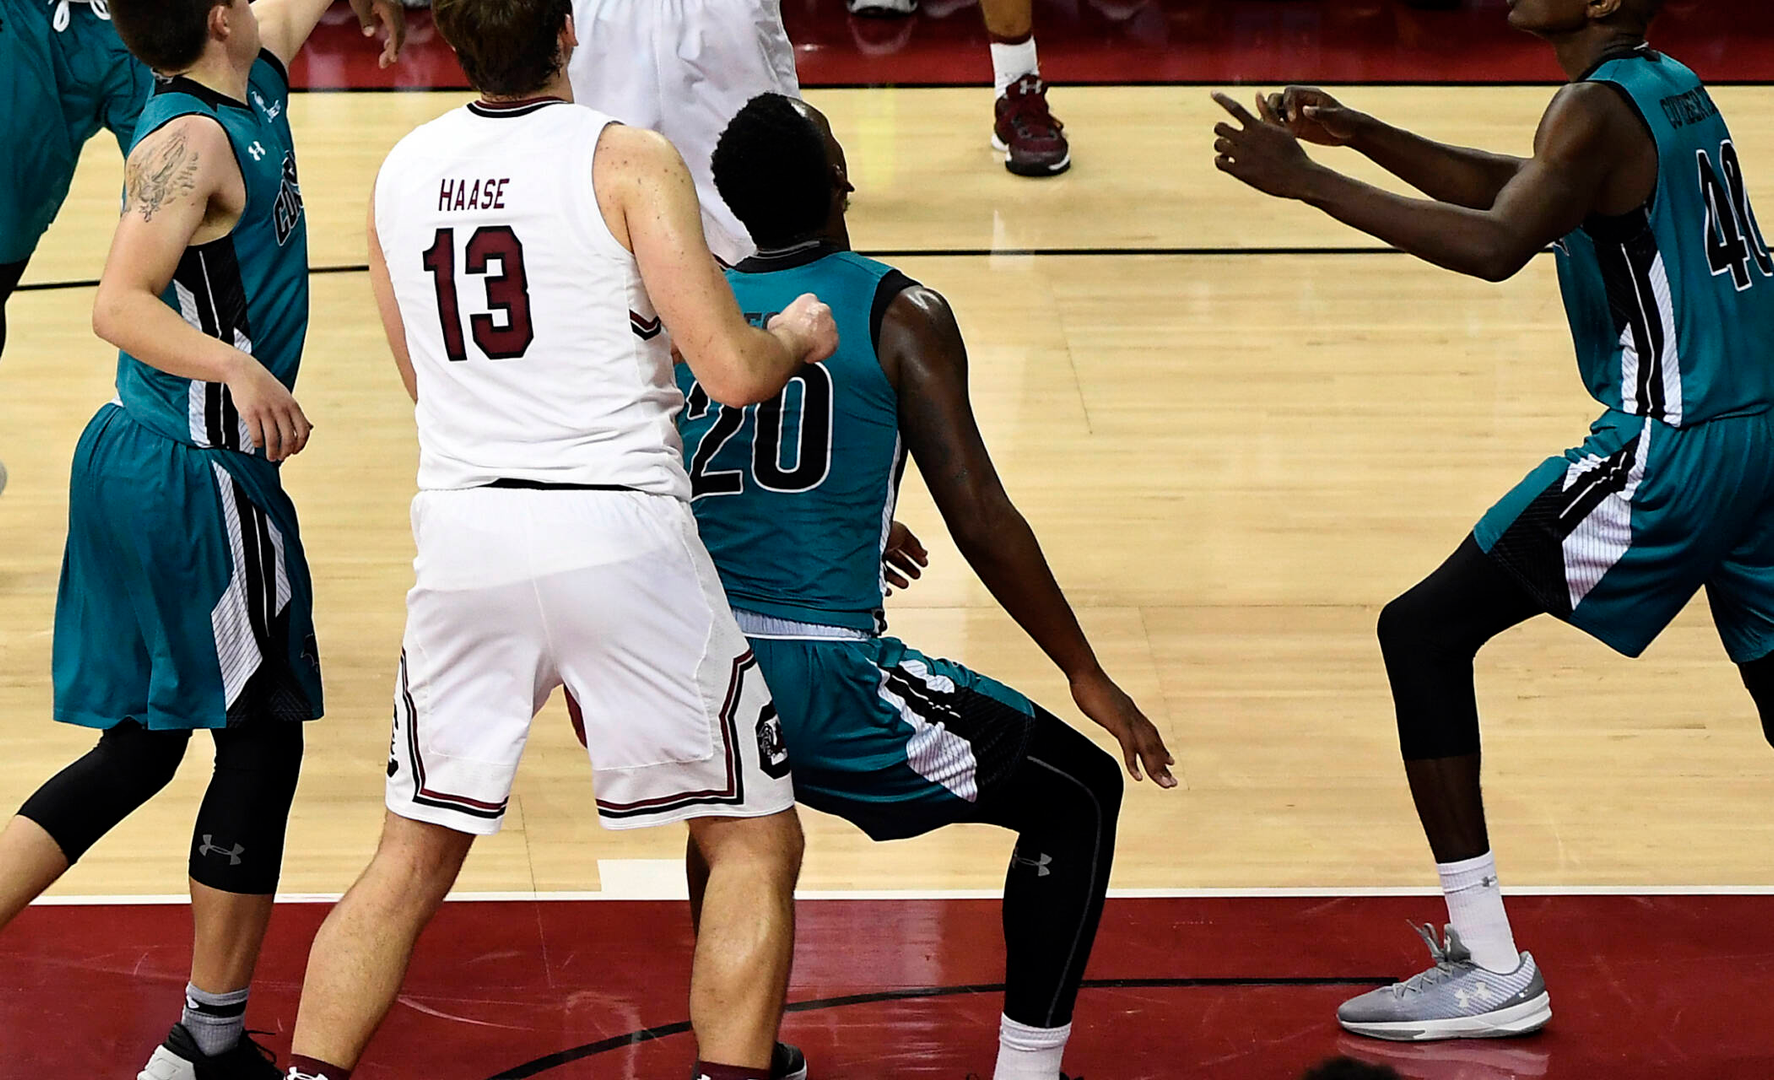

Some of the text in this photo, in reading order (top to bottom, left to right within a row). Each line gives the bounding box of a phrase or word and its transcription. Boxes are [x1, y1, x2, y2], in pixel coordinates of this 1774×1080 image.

[438, 178, 510, 211] HAASE
[422, 225, 534, 362] 13
[684, 361, 834, 503] 20
